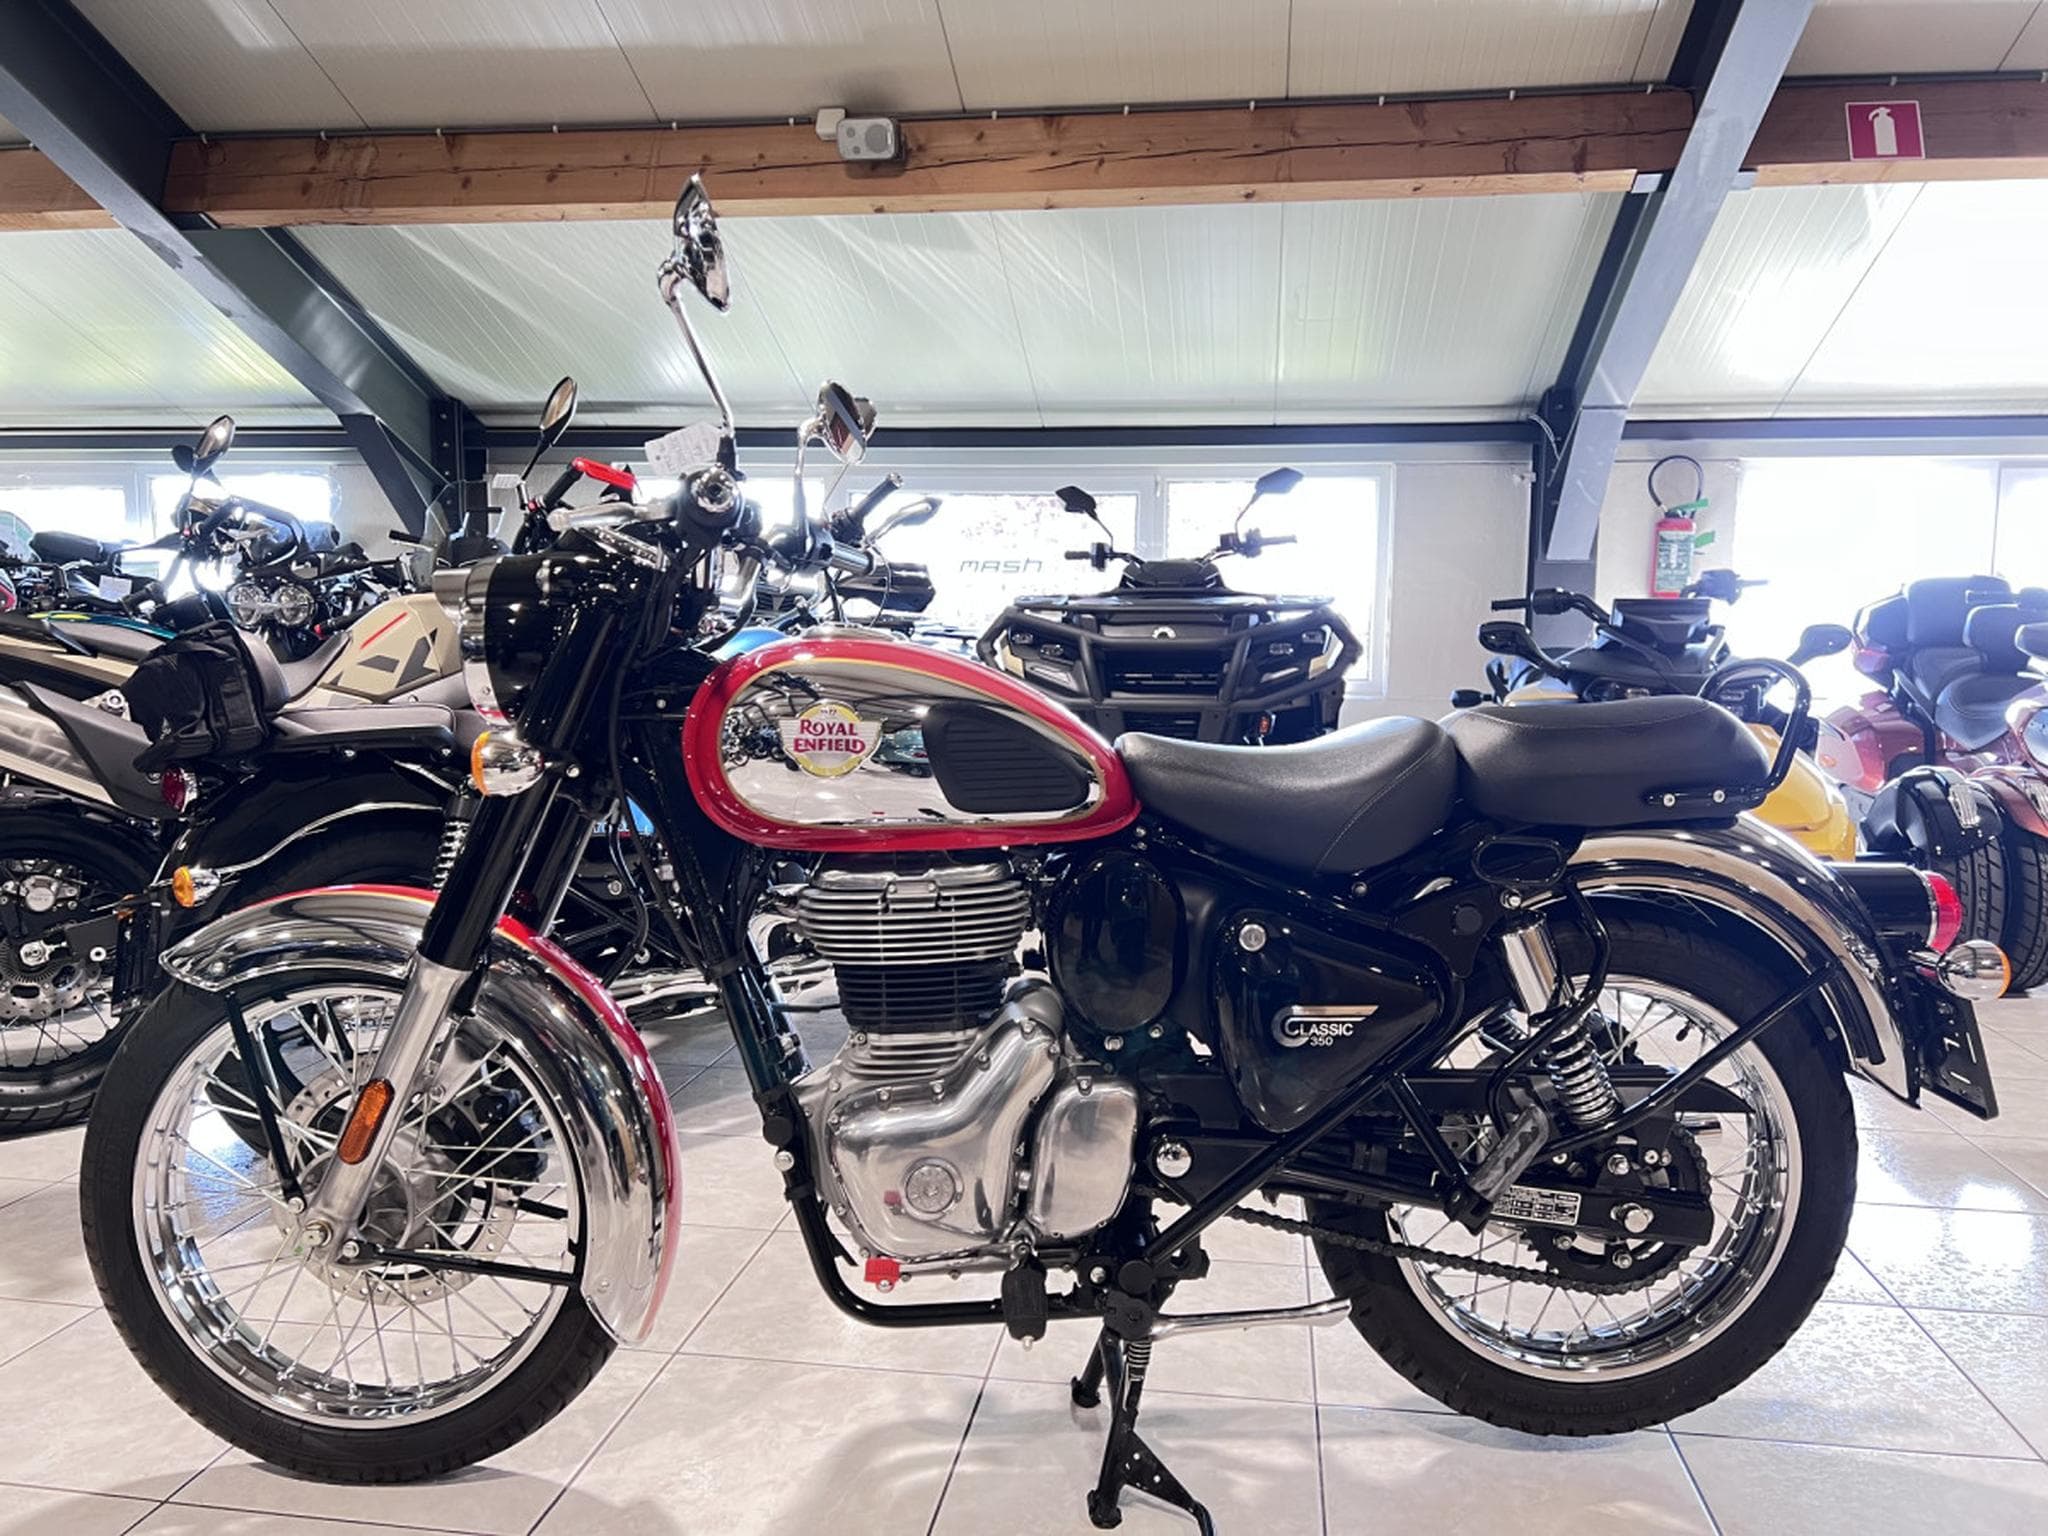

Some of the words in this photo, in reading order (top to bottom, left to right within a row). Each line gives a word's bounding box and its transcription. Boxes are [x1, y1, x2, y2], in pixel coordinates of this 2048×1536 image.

[800, 719, 858, 736] ROYAL
[793, 737, 866, 754] ENFIELD
[1284, 1017, 1354, 1036] CLASSIC
[1310, 1036, 1333, 1047] 350
